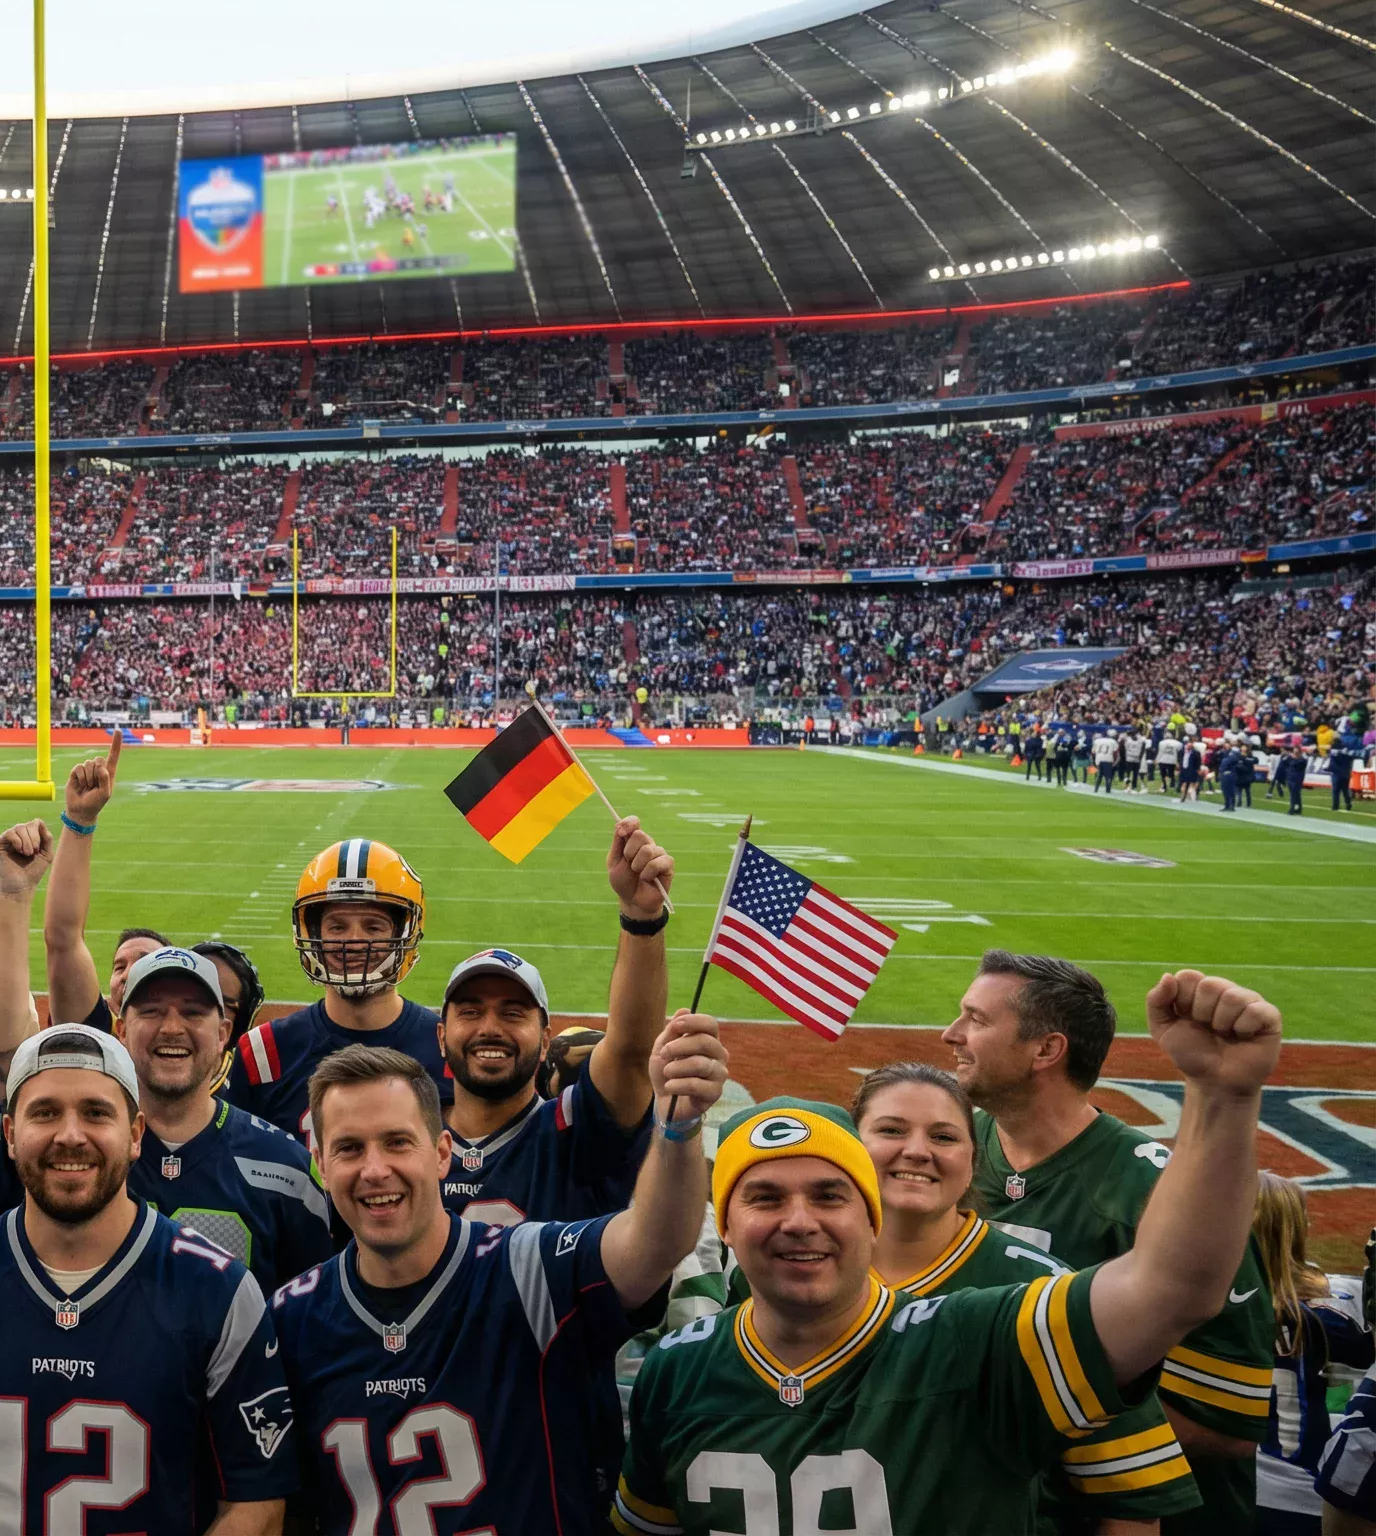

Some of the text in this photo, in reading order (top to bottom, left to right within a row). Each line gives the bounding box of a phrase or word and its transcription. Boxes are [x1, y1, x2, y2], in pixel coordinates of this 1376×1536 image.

[749, 1116, 811, 1149] G
[32, 1357, 95, 1382] PATRIOTS
[321, 1401, 488, 1536] 12
